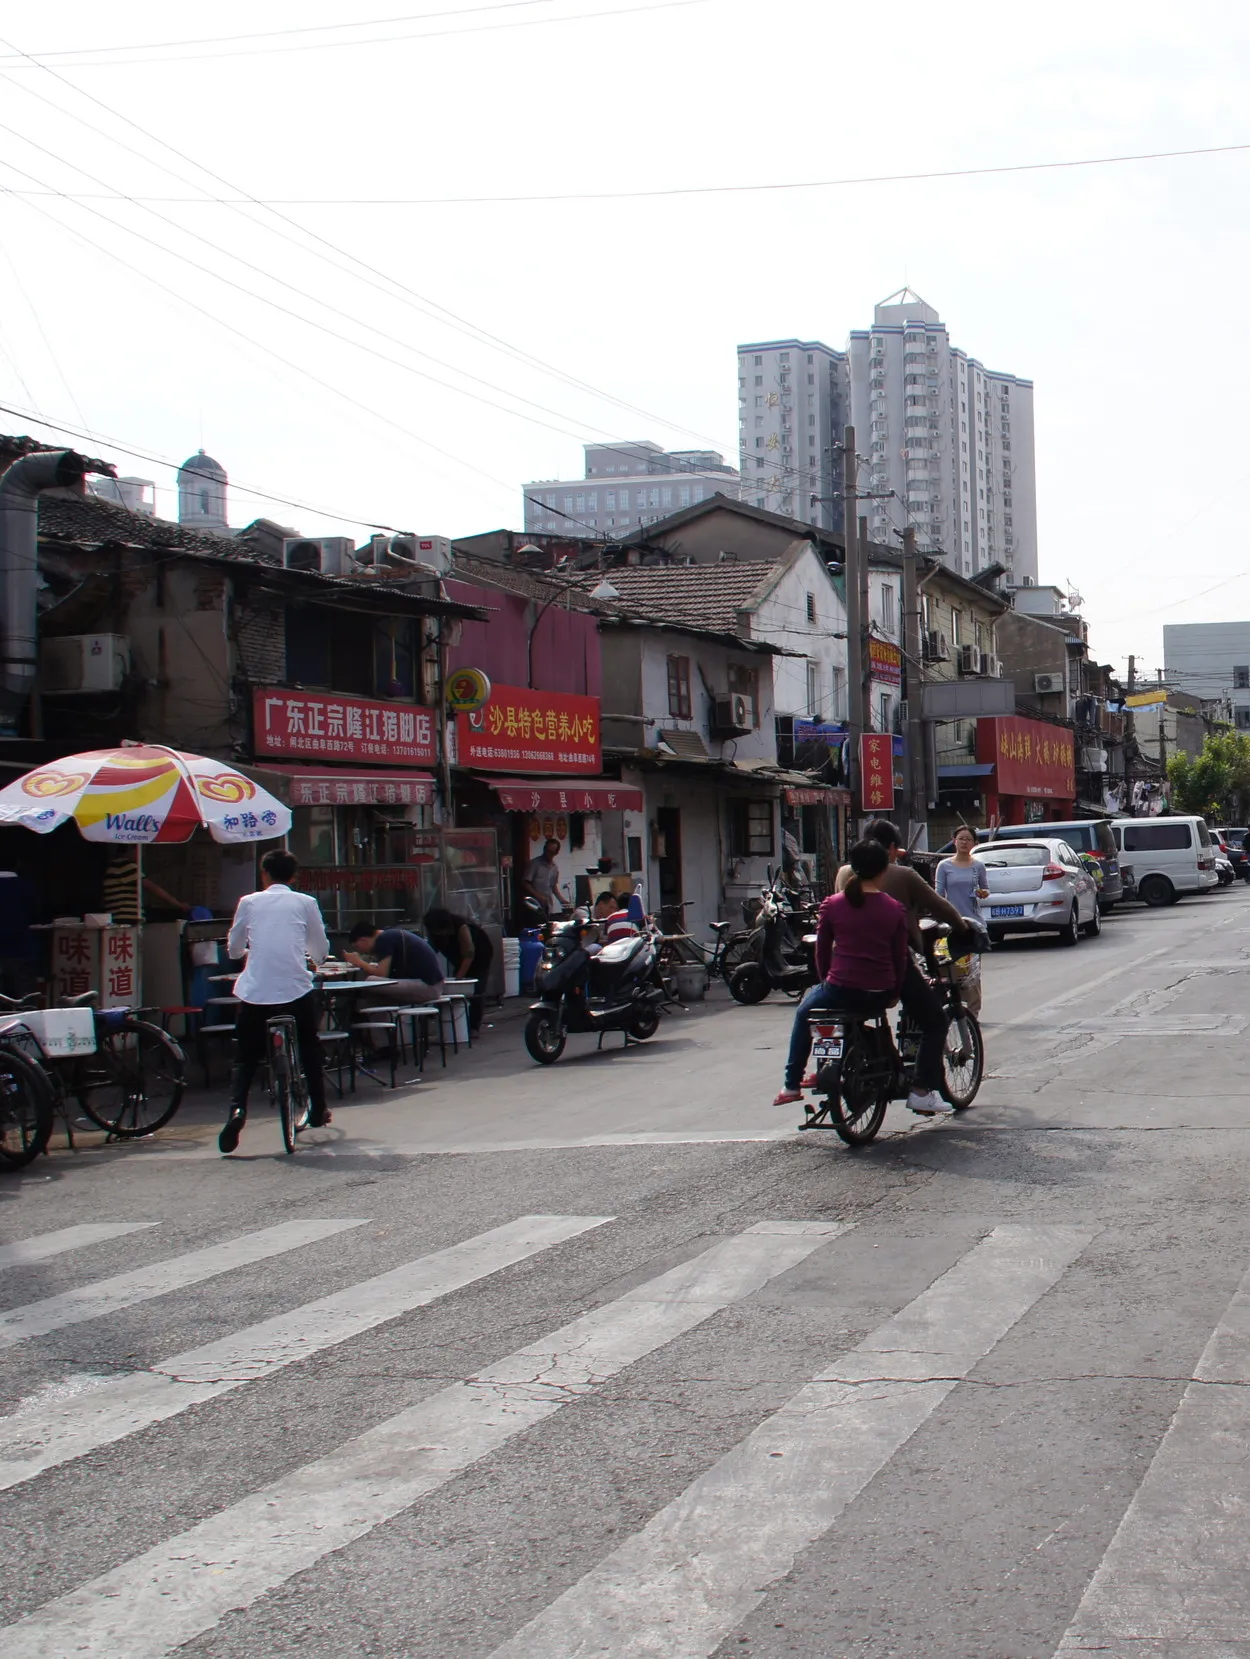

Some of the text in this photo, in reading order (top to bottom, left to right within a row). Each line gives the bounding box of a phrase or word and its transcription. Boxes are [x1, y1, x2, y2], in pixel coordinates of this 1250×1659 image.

[265, 697, 431, 744] 广东正宗隆江猪脚店
[489, 705, 596, 744] 沙县特色营养小吃
[868, 738, 884, 805] 家电维修
[223, 809, 278, 831] 和路雪
[531, 791, 617, 808] 沙县小吃
[105, 812, 161, 834] Wall's
[59, 934, 92, 998] 味道
[108, 931, 134, 998] 味道
